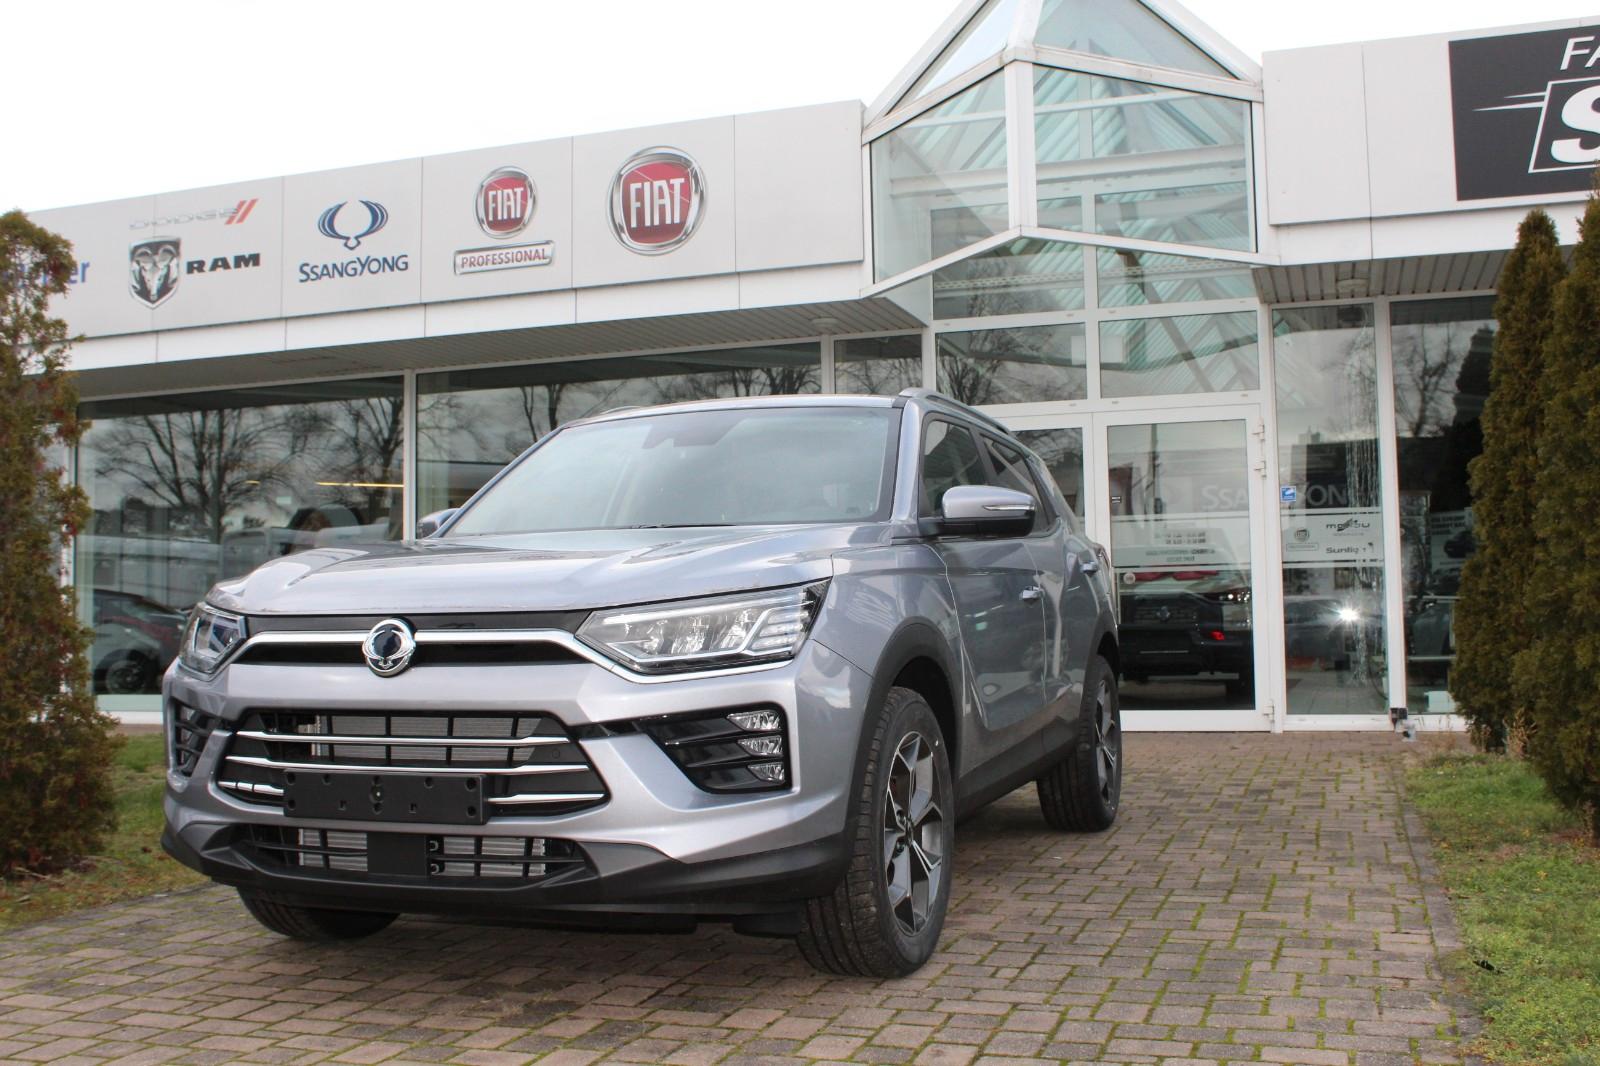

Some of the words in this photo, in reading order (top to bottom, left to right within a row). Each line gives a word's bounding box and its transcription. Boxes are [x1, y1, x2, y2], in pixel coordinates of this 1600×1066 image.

[487, 187, 524, 223] FIAT
[629, 178, 685, 229] FIAT
[186, 252, 261, 275] RAM
[459, 248, 547, 268] PROFESSIONAL
